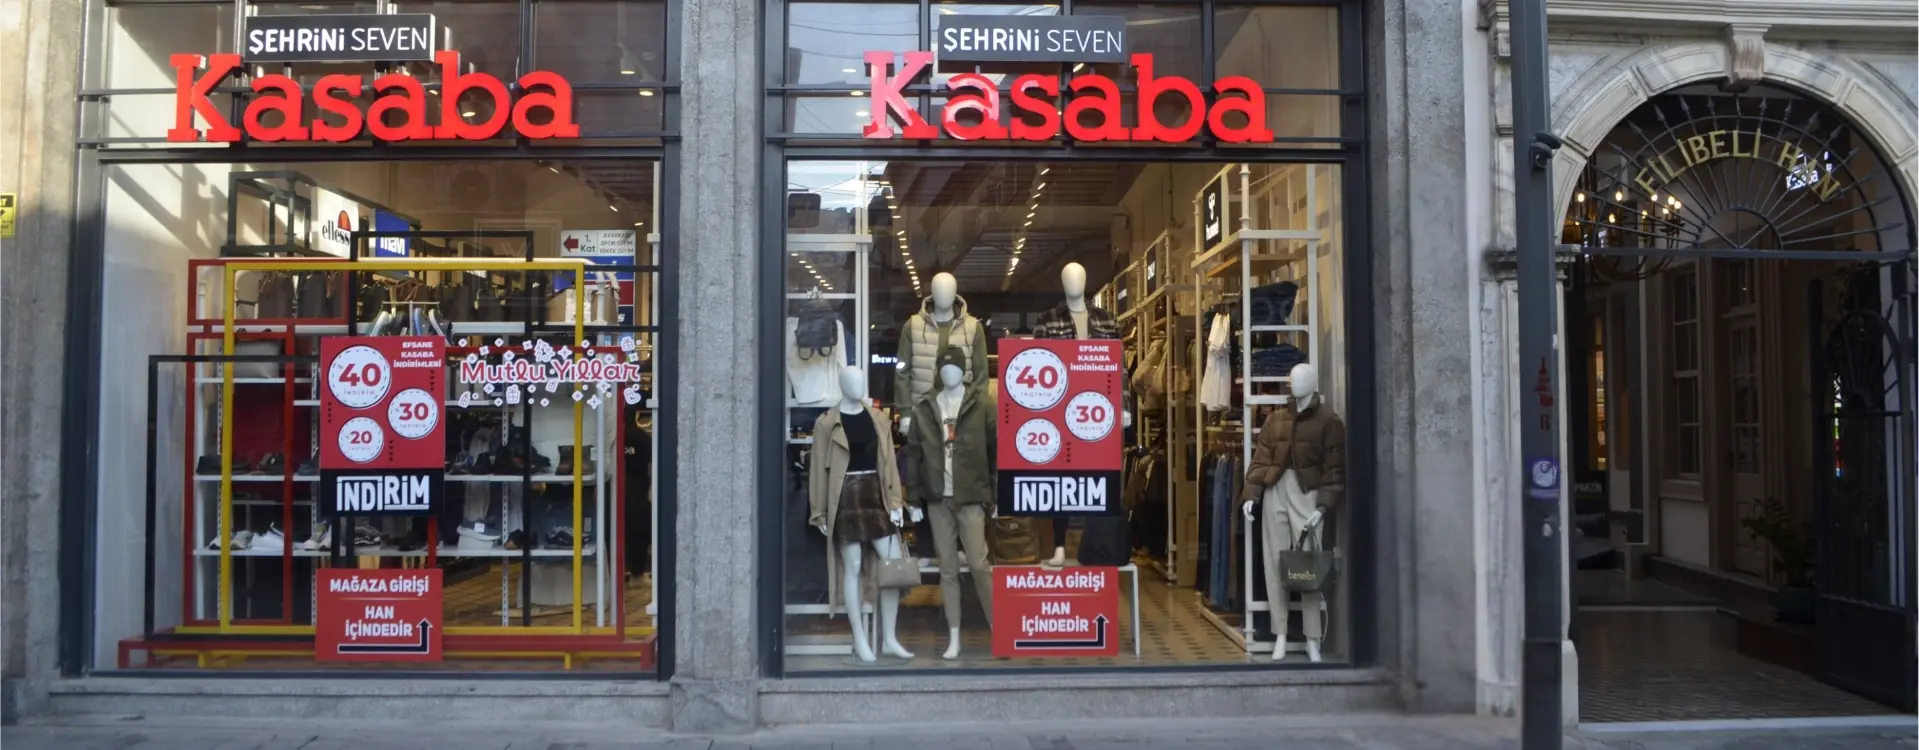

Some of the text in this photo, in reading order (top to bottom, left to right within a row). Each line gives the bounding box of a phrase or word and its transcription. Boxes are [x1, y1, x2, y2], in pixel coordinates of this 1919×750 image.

[350, 27, 427, 51] SEVEN
[1046, 30, 1123, 54] SEVEN
[168, 50, 580, 143] Kasaba
[863, 51, 1274, 143] Kasaba
[1776, 141, 1841, 203] HAN
[580, 244, 596, 253] Kat
[461, 359, 640, 383] Mutlu Yıllar
[329, 575, 429, 597] MAĞAZA GİRİŞİ
[1006, 571, 1105, 593] MAĞAZA GİRİŞİ
[364, 605, 395, 620] HAN
[1041, 601, 1071, 616] HAN
[344, 619, 413, 641] İÇİNDEDİR
[1021, 614, 1089, 637] İÇİNDEDİR
